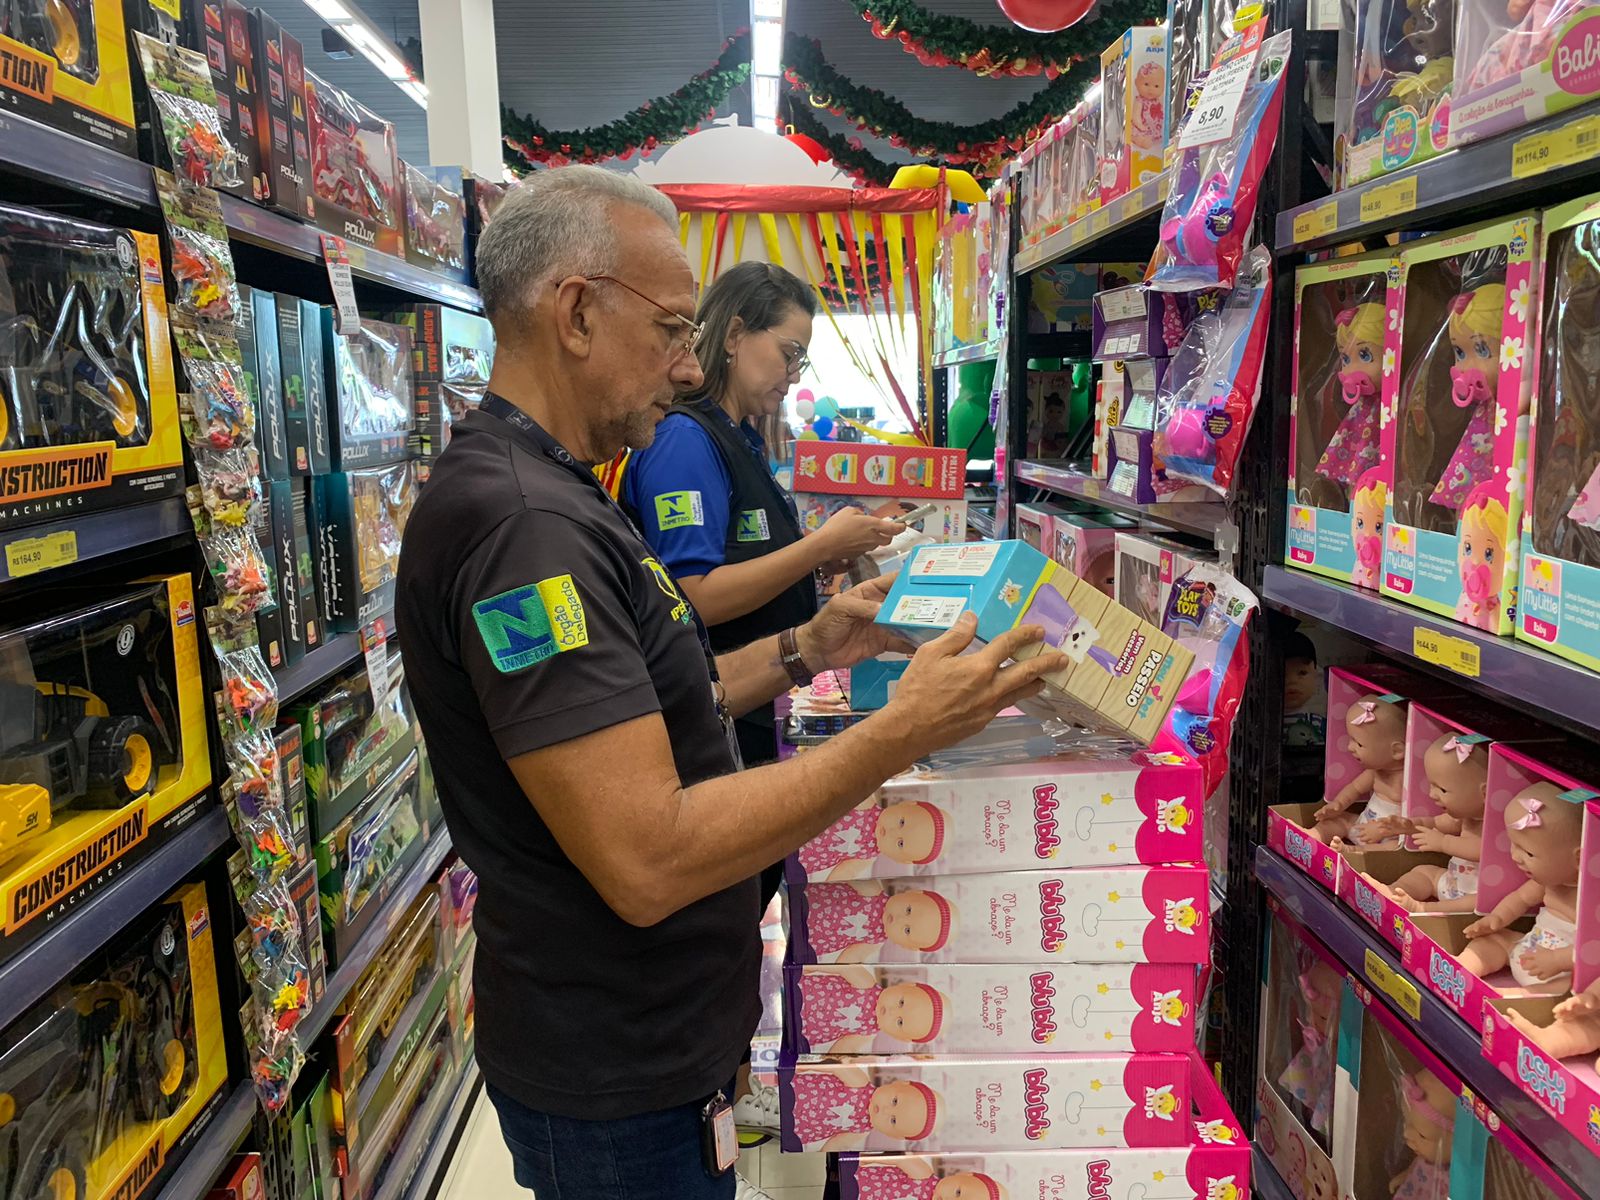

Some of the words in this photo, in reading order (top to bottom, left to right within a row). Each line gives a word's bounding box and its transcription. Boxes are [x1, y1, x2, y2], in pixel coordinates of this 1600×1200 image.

[1198, 105, 1224, 125] 8,90
[344, 219, 375, 243] POLLUX
[661, 516, 690, 527] INMETRO
[282, 537, 300, 642] POLLUX
[561, 581, 586, 643] Delegado
[1177, 600, 1199, 617] TOYS
[554, 605, 577, 646] Órgão
[499, 643, 556, 671] INMETRO
[1126, 649, 1163, 707] PASSEIO
[996, 799, 1011, 821] Me
[1155, 798, 1168, 834] Anjo
[14, 808, 144, 924] CONSTRUCTION
[47, 861, 123, 921] MACHINES
[1002, 893, 1017, 914] Me
[1164, 898, 1176, 932] Anjo
[994, 986, 1008, 1006] Me
[1152, 991, 1163, 1024] Anjo
[988, 1082, 1002, 1104] Me
[1145, 1086, 1156, 1119] Anjo
[1194, 1120, 1211, 1145] Anjo
